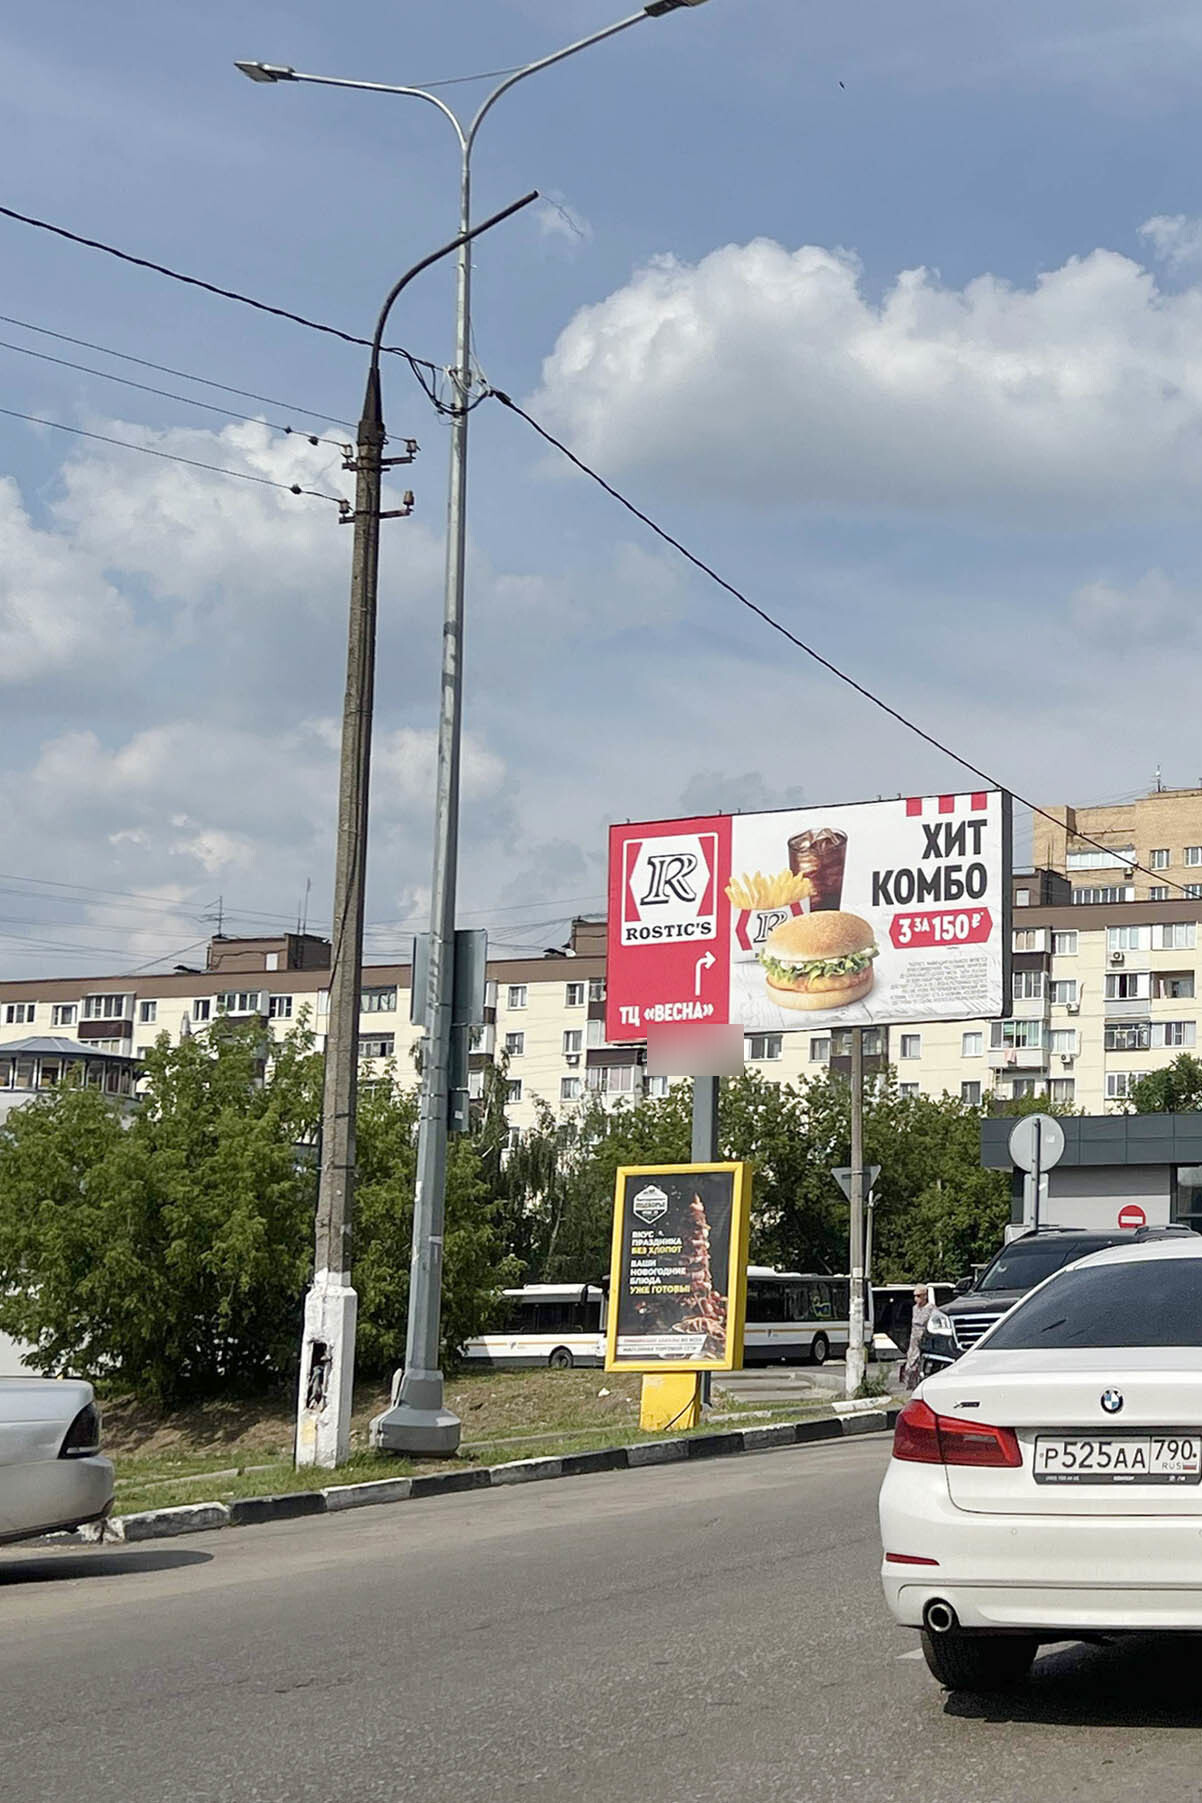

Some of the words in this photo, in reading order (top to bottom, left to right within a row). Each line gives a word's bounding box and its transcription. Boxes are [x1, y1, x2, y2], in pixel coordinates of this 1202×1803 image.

[921, 818, 988, 860] ХИТ
[871, 861, 988, 907] КОМБО
[625, 921, 712, 941] ROSTIC'S
[897, 917, 913, 944] 3
[619, 1004, 641, 1027] ТЦ
[643, 1001, 715, 1023] «ВЕСНА»
[631, 1237, 683, 1247] ПРАЗДНИКА
[648, 1246, 683, 1254] ХЛОПОТ
[630, 1267, 687, 1277] НОВОГОДНИЕ
[630, 1276, 662, 1286] БЛЮДА
[630, 1285, 650, 1295] УЖЕ
[1153, 1439, 1194, 1461] 790
[1161, 1461, 1182, 1471] RUS
